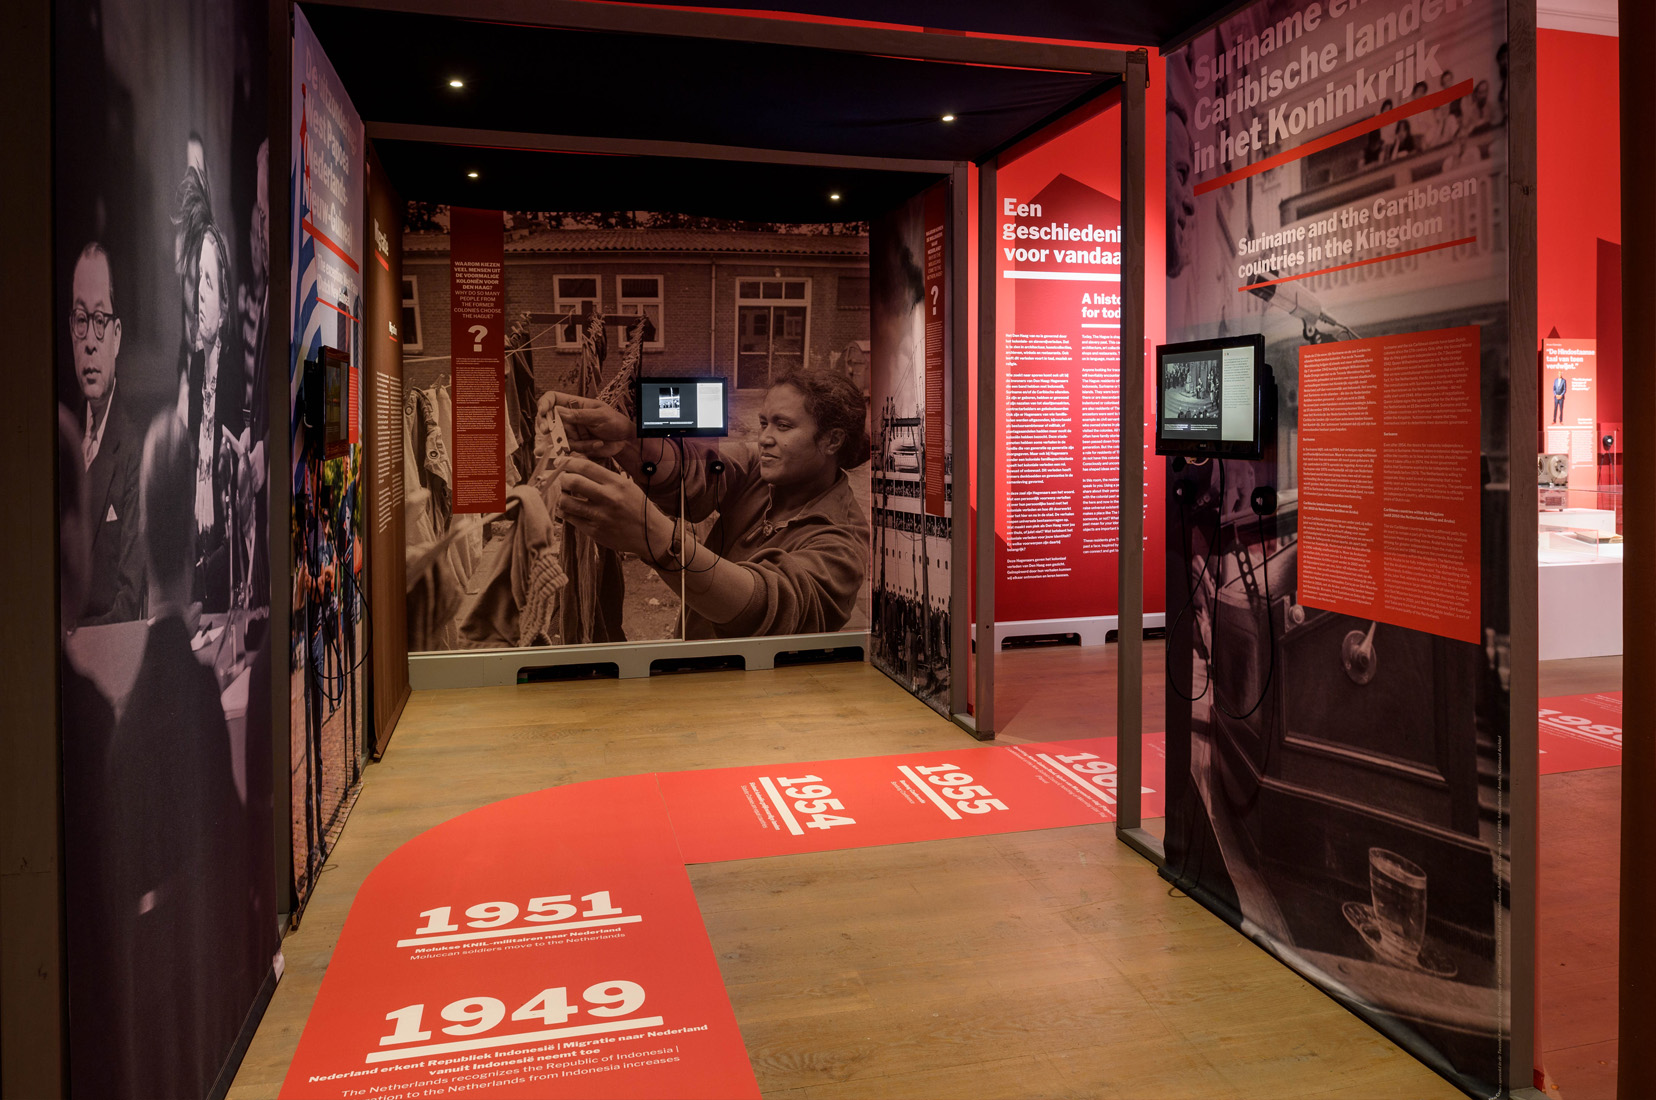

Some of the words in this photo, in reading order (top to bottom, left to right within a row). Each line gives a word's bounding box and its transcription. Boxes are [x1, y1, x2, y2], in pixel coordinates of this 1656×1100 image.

[1194, 3, 1321, 89] Suriname
[1329, 0, 1369, 18] e
[1194, 43, 1338, 130] Caribische
[1195, 141, 1214, 174] in
[1220, 117, 1261, 164] het
[1268, 38, 1443, 145] Koninkrijk
[305, 90, 326, 137] West
[1004, 198, 1042, 217] Een
[1238, 226, 1305, 256] Suriname
[1308, 212, 1337, 238] and
[1341, 207, 1369, 229] the
[1372, 177, 1477, 220] Caribbean
[1003, 222, 1121, 243] geschiedeni
[1238, 249, 1305, 279] countries
[1308, 244, 1322, 263] in
[1325, 235, 1353, 259] the
[1356, 216, 1442, 250] Kingdom
[1004, 248, 1049, 262] voor
[1053, 246, 1121, 265] vandaa
[931, 286, 939, 315] ?
[1082, 293, 1091, 304] A
[1094, 293, 1121, 305] histo
[1082, 307, 1099, 318] for
[1102, 307, 1121, 318] tod
[468, 325, 488, 352] ?
[776, 774, 856, 830] 1954
[915, 764, 1010, 814] 1955
[416, 890, 622, 935] 1951
[410, 950, 460, 960] Moluccan
[462, 946, 502, 956] soldiers
[566, 933, 626, 944] Netherlands
[414, 944, 460, 954] Molukse
[462, 936, 543, 949] KNIL-militairen
[570, 927, 622, 937] Nederland
[378, 980, 646, 1046] 1949
[308, 1068, 378, 1083] Nederland
[380, 1061, 425, 1074] erkent
[428, 1053, 492, 1067] Republiek
[494, 1045, 555, 1057] Indonesië
[563, 1036, 616, 1049] Migratie
[618, 1033, 645, 1042] naar
[647, 1024, 708, 1038] Nederland
[370, 1077, 449, 1094] Netherlands
[451, 1068, 520, 1082] recognizes
[523, 1063, 543, 1073] the
[546, 1056, 599, 1070] Republic
[601, 1054, 613, 1062] of
[616, 1047, 673, 1060] Indonesia
[423, 1087, 445, 1096] the
[448, 1076, 526, 1093] Netherlands
[529, 1072, 559, 1081] from
[562, 1064, 620, 1077] Indonesia
[623, 1056, 680, 1068] increases
[429, 1064, 470, 1075] vanuit
[473, 1056, 534, 1071] Indonesië
[537, 1051, 577, 1062] neemt
